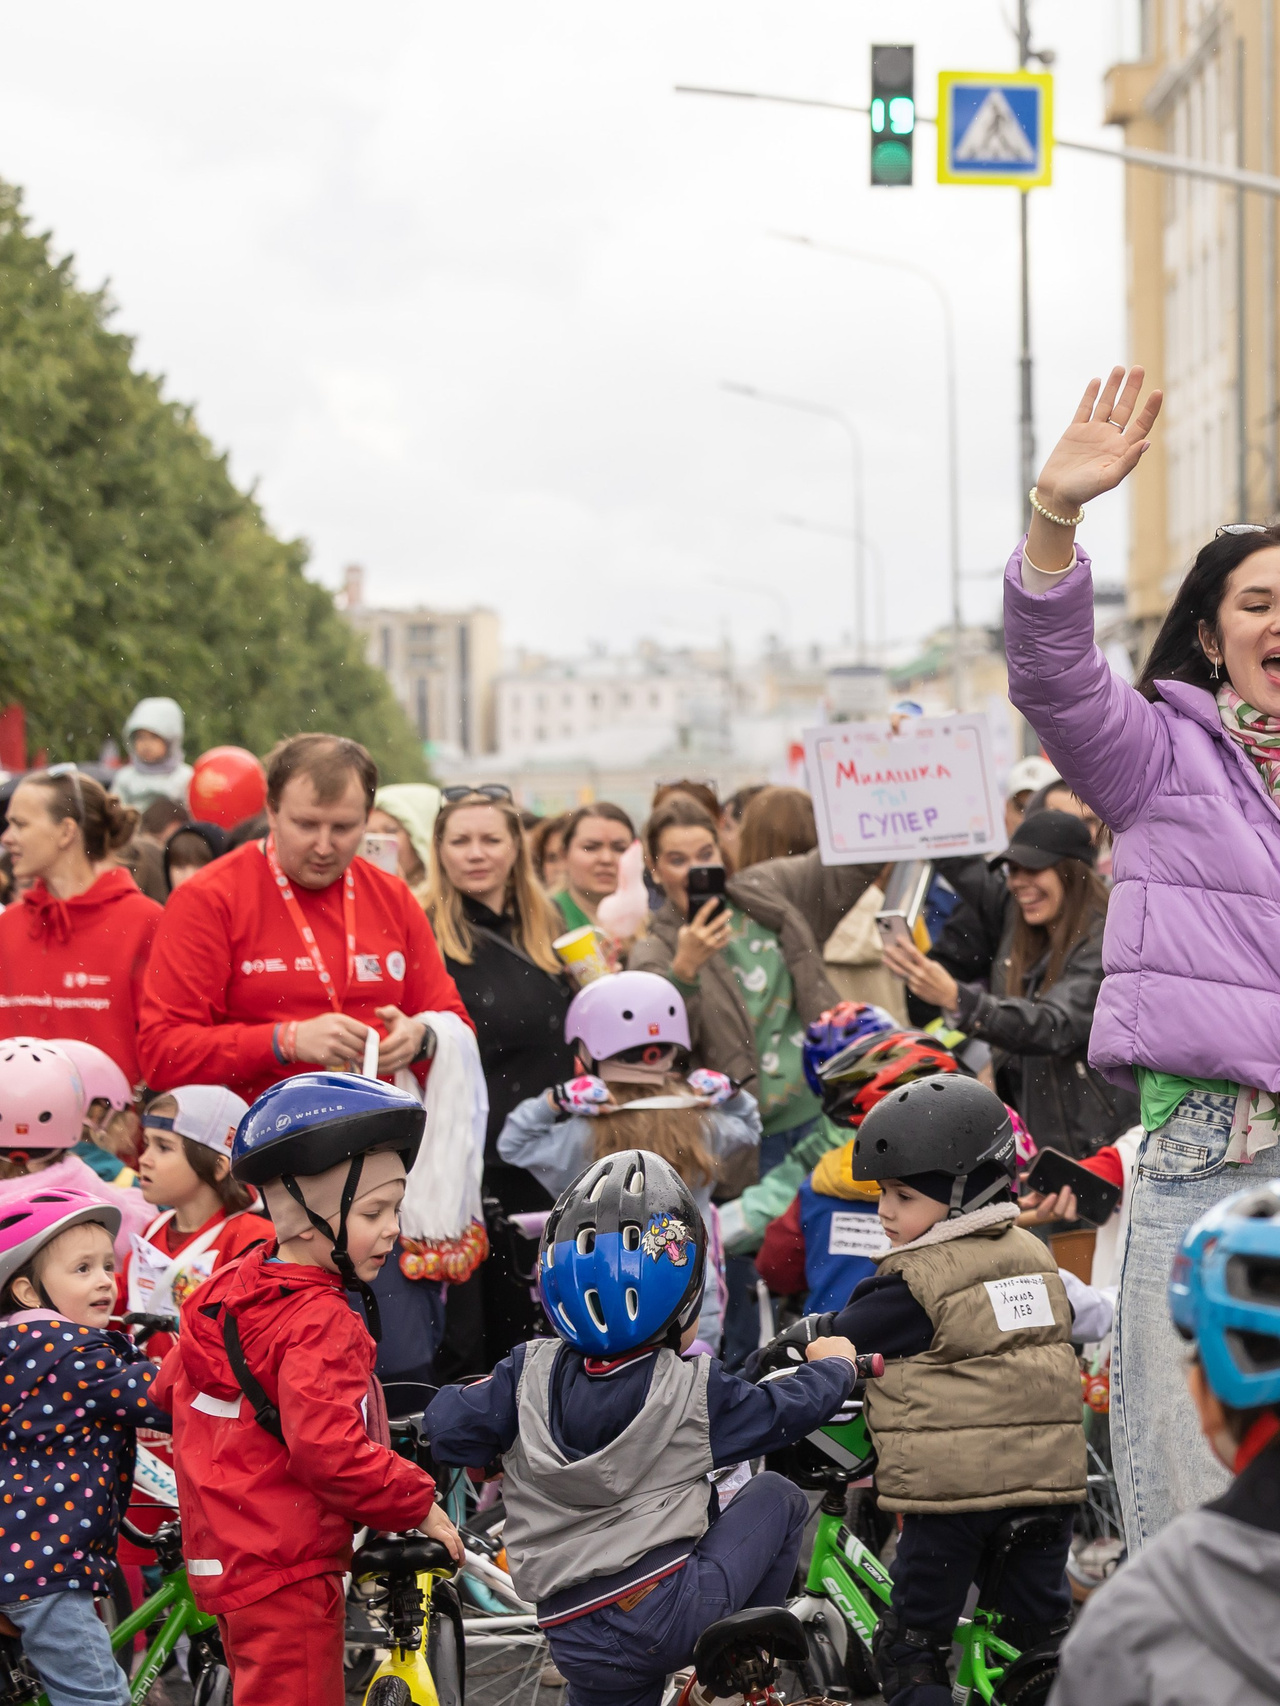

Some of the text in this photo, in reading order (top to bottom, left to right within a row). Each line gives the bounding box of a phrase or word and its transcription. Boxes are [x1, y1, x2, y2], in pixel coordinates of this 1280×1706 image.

[872, 97, 915, 135] 19
[858, 807, 938, 840] СУПЕР
[295, 1105, 344, 1120] WHEELS
[132, 1646, 170, 1706] SHULZ
